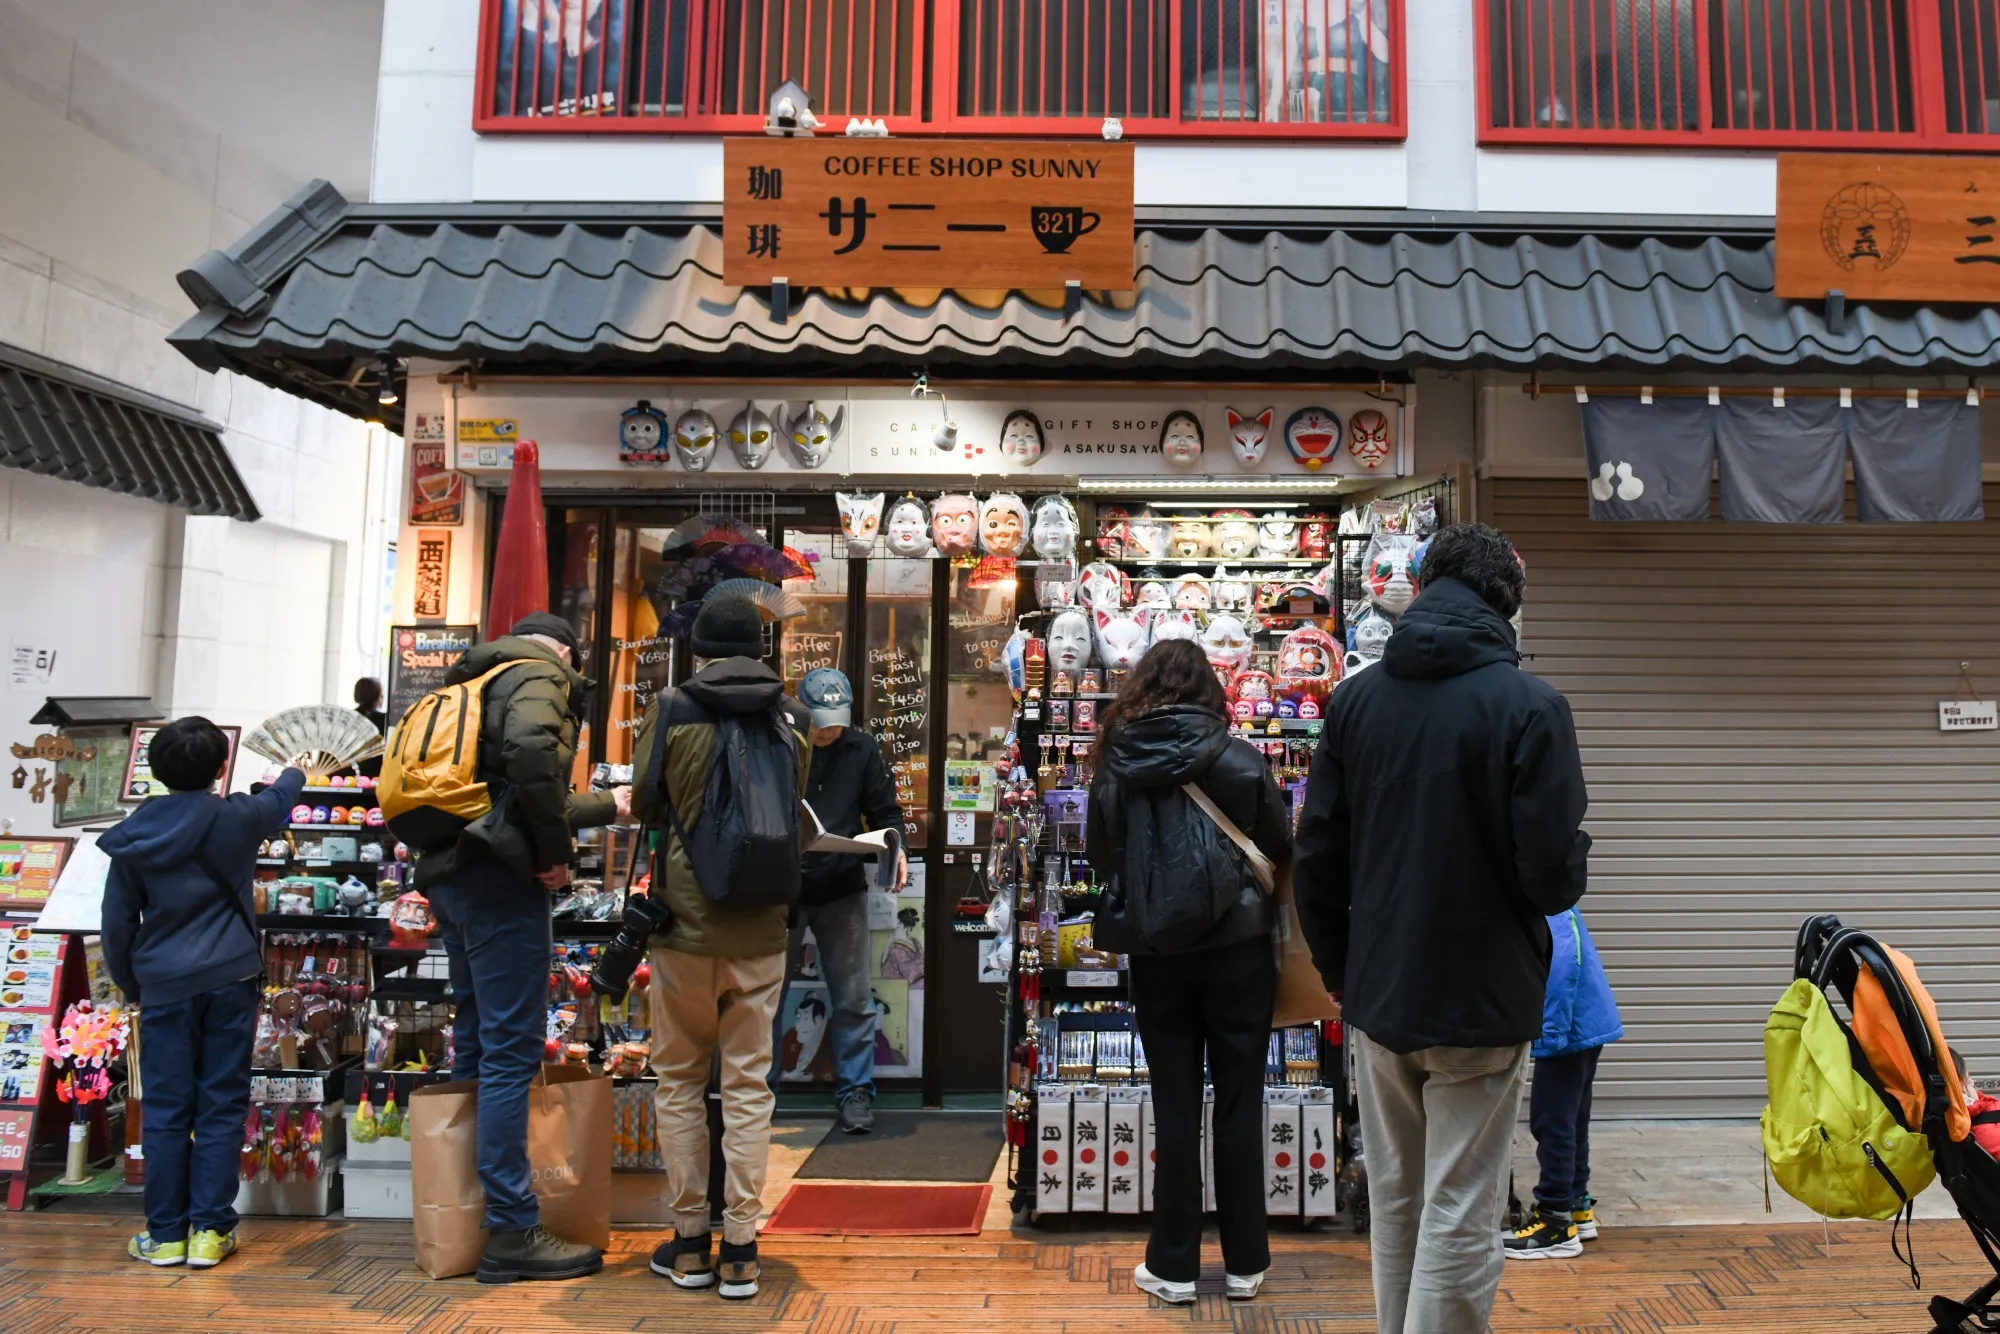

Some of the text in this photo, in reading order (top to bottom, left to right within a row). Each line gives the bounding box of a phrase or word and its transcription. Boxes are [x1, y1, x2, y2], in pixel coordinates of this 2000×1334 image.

[824, 155, 1101, 179] COFFEE SHOP SUNNY
[747, 165, 783, 260] 珈琲
[818, 196, 1007, 255] サニー
[1037, 212, 1074, 235] 321
[890, 422, 937, 433] CAF
[1045, 420, 1159, 430] GIFT SHOP
[870, 447, 937, 457] SUNN
[415, 632, 470, 650] Breakfast
[402, 650, 444, 670] Special
[868, 647, 906, 664] Break
[888, 660, 916, 673] fast
[871, 667, 922, 689] Special
[823, 693, 841, 703] NY
[870, 711, 928, 729] everyday
[22, 745, 82, 761] WELCOME
[954, 921, 997, 933] welcom
